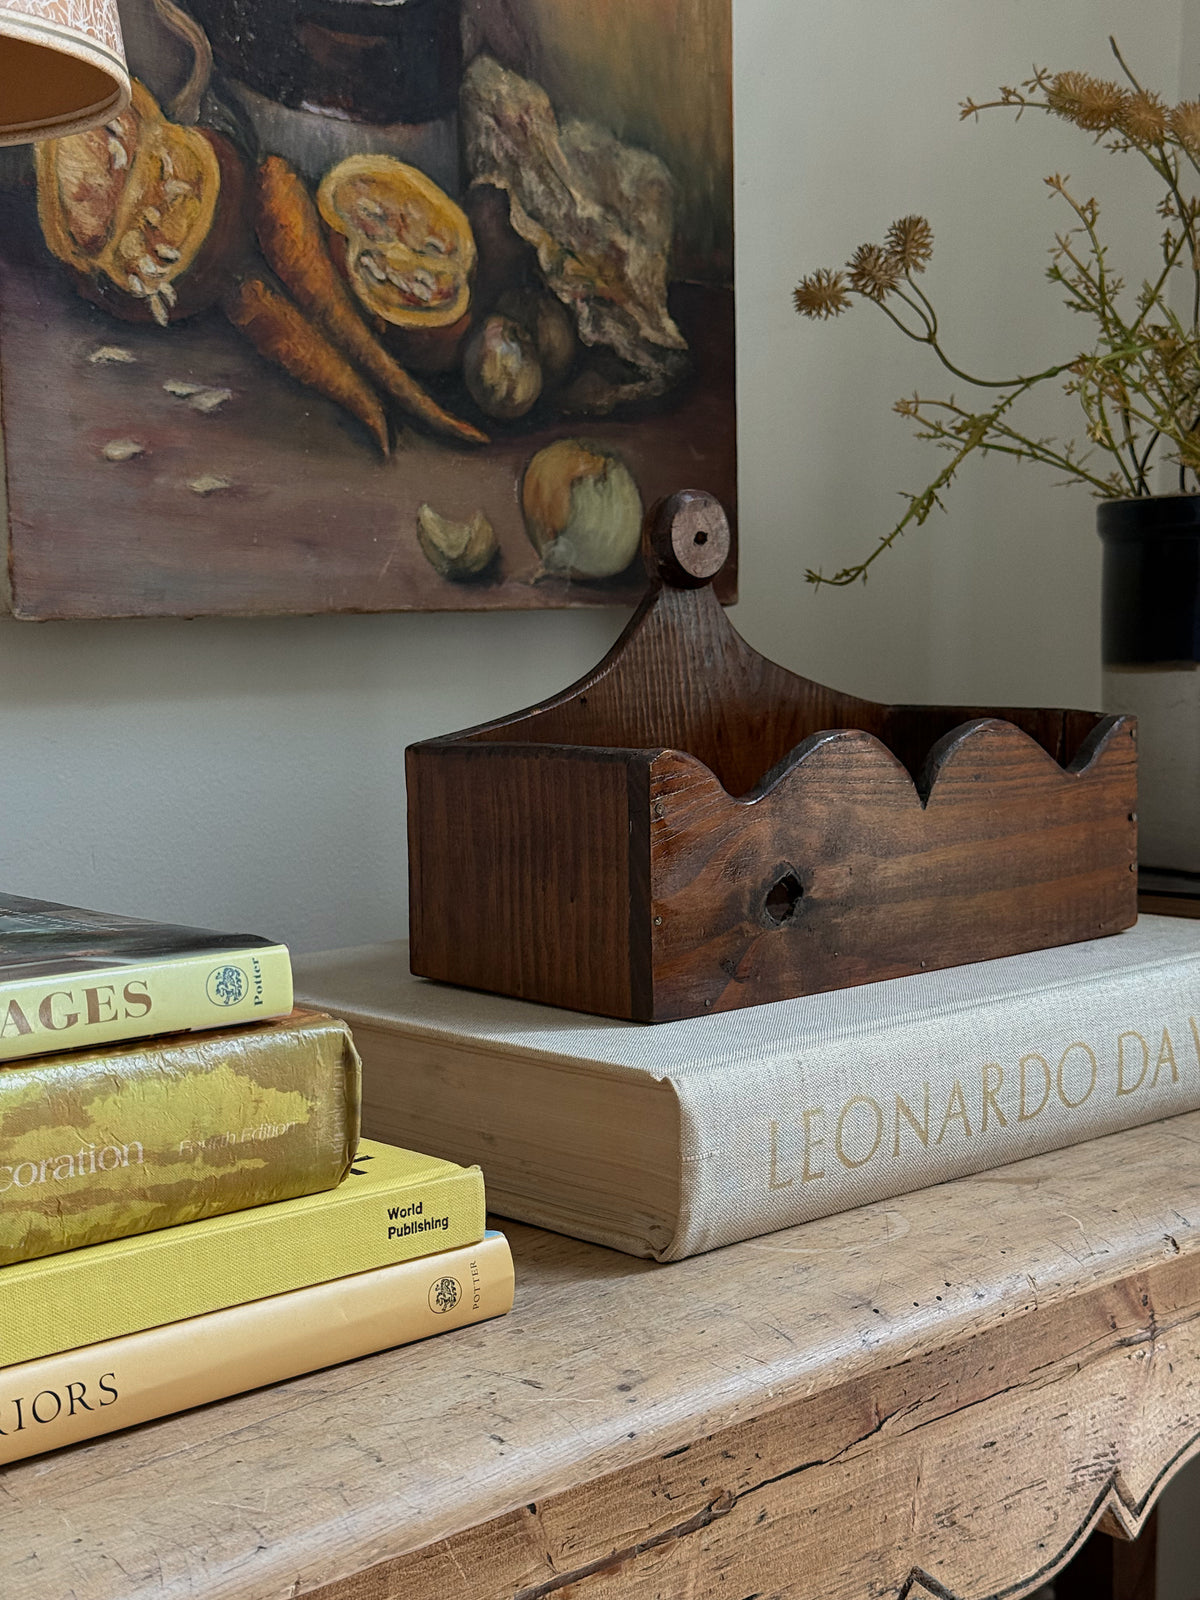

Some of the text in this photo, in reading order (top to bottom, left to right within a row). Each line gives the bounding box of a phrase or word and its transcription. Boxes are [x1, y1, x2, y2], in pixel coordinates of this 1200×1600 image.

[250, 957, 264, 1006] Potter
[0, 980, 153, 1039] AGES
[768, 1041, 1098, 1190] LEONARDO
[1115, 1025, 1180, 1096] DA
[241, 1121, 296, 1144] Edition
[387, 1201, 423, 1221] World
[387, 1216, 450, 1240] Publishing
[469, 1260, 481, 1310] POTTER
[0, 1372, 119, 1436] IORS
